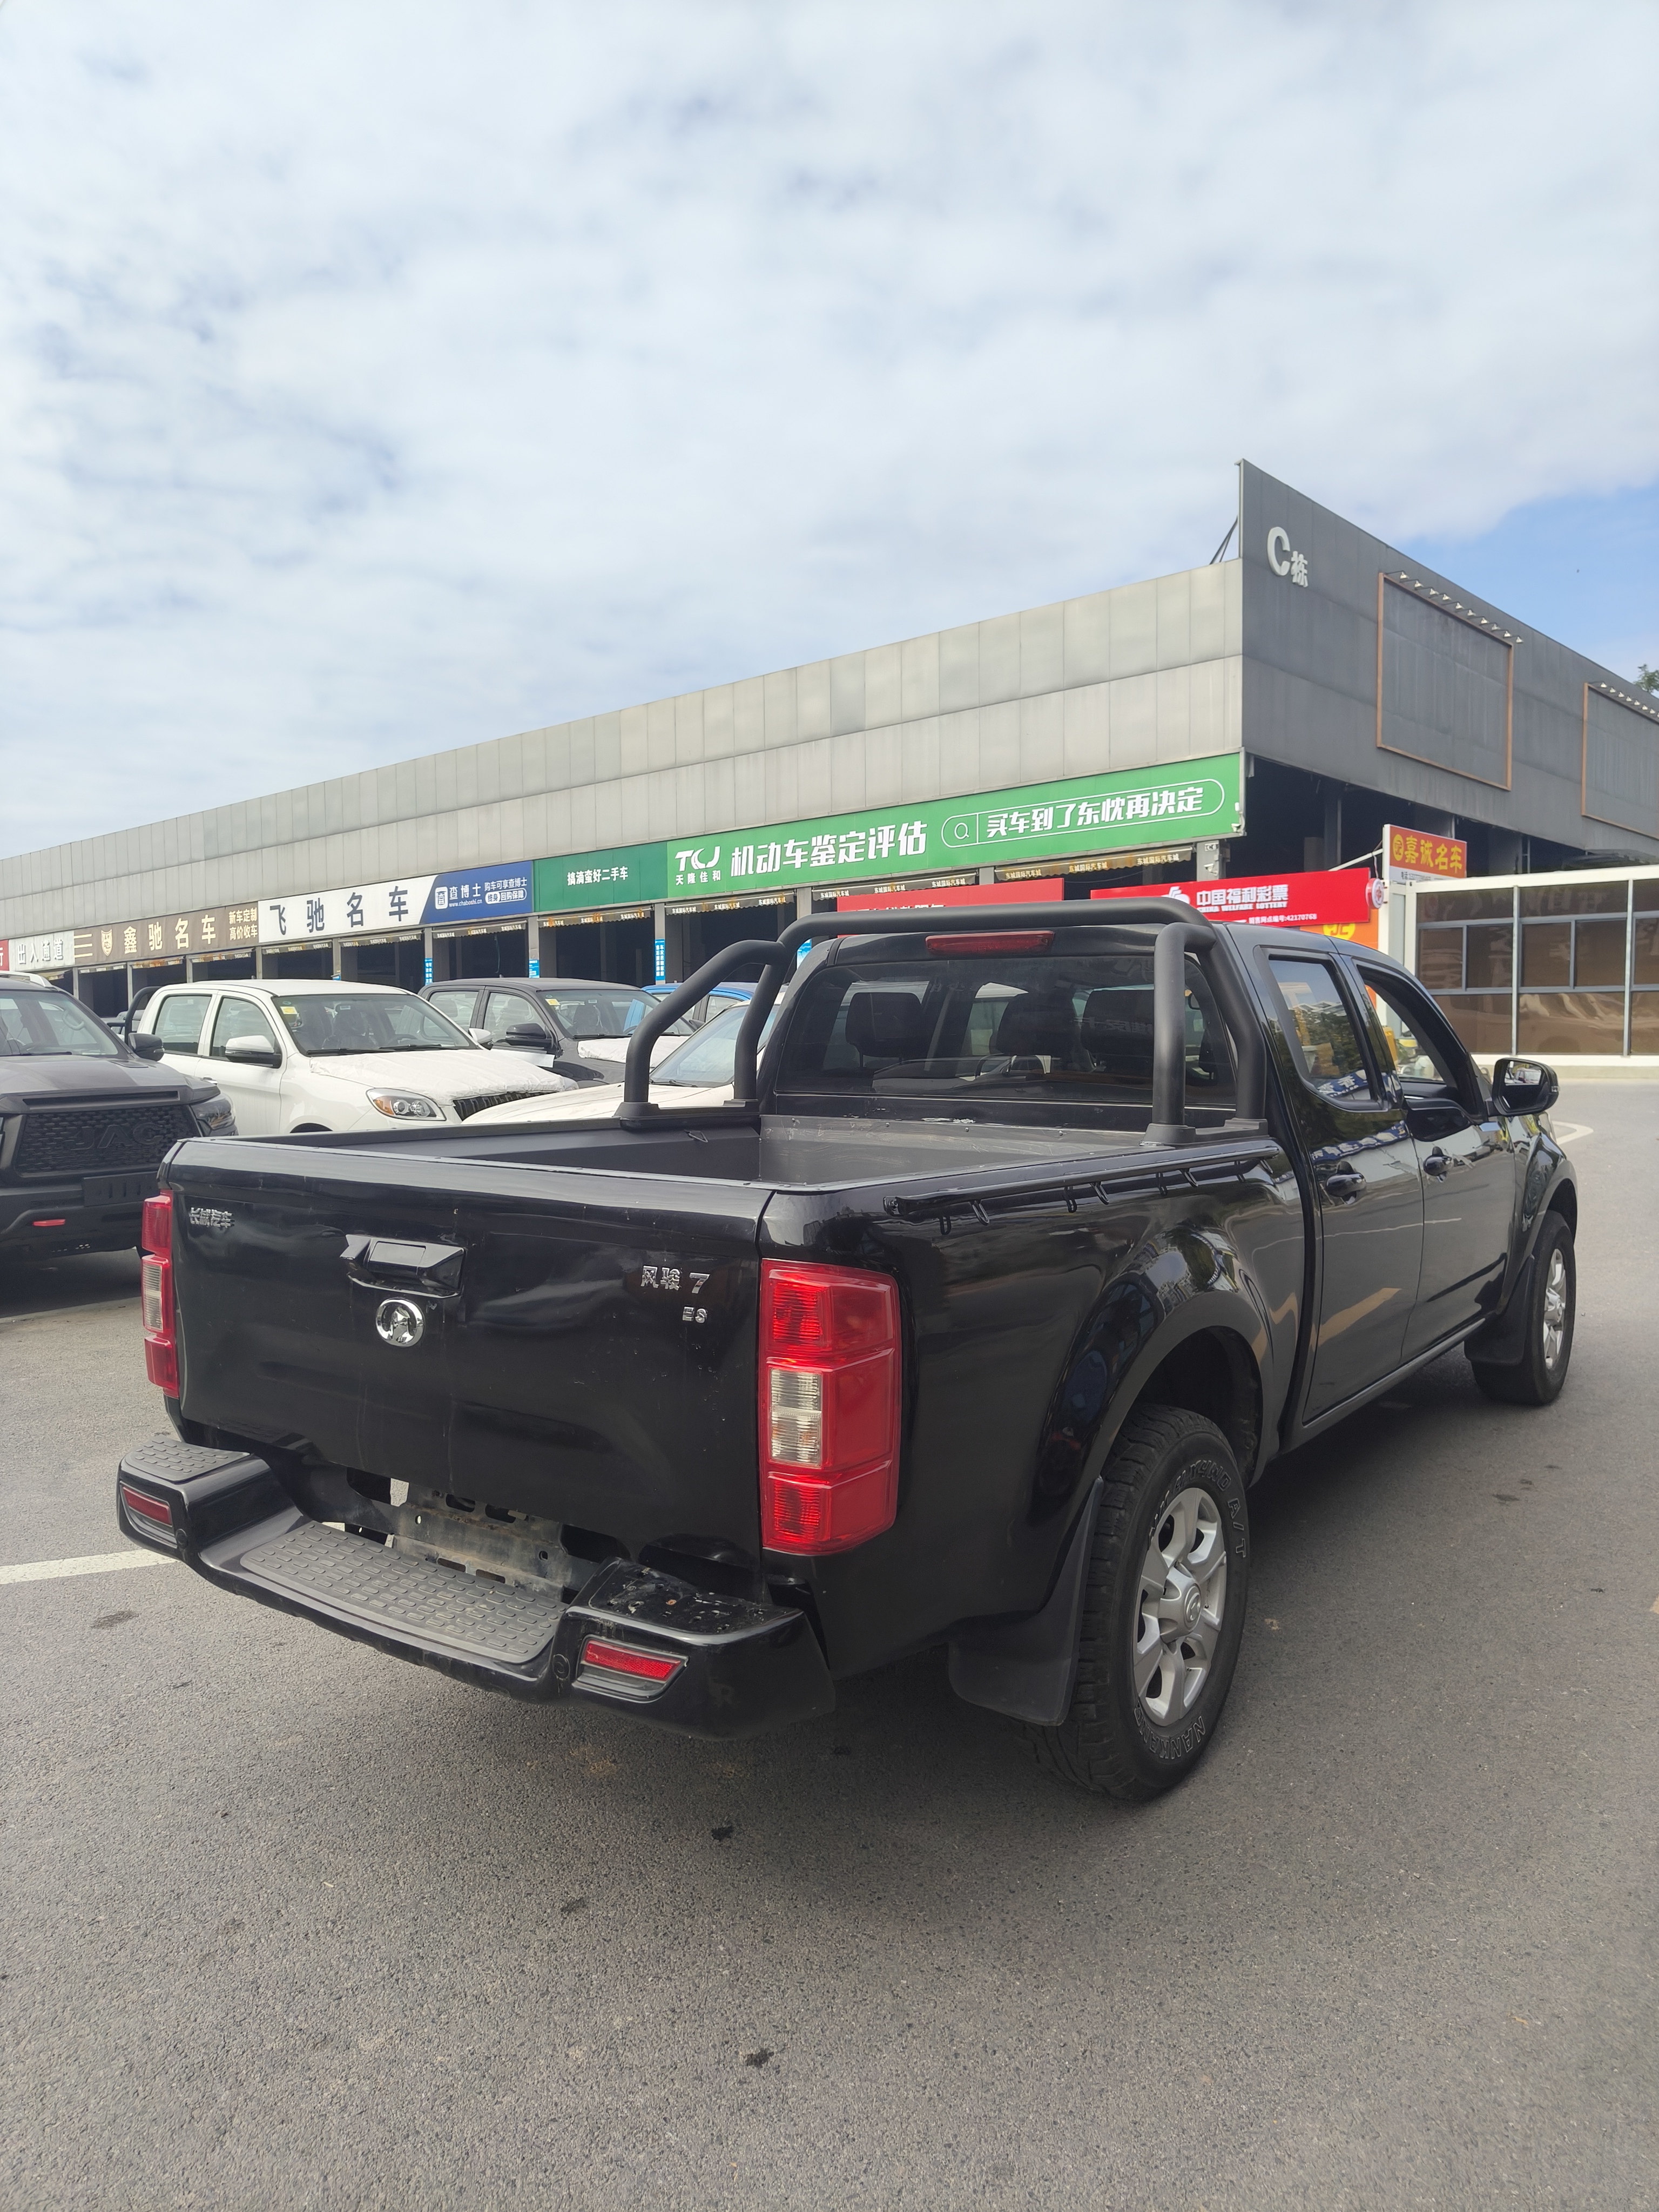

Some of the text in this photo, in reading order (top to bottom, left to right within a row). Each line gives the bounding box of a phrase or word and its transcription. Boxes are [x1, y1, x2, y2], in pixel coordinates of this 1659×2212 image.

[1267, 527, 1309, 588] C栋
[987, 787, 1203, 838] 买车到了东忱再决定
[731, 820, 927, 877] 机动车鉴定评估
[1404, 835, 1462, 873] 嘉诚名车
[1068, 861, 1108, 873] 东城国际汽车城
[1137, 854, 1179, 865] 东城国际汽车城
[484, 877, 528, 891] 购车可享查博士
[567, 866, 629, 886] 搞滴蛮好二手车
[676, 870, 721, 886] 天隆佳和
[931, 878, 966, 887] 东城国际汽车城
[449, 883, 481, 900] 查博士
[1196, 884, 1289, 906] 中国福利彩票
[229, 907, 257, 925] 新车定制
[269, 886, 409, 935] 飞驰名车
[124, 914, 216, 954] 鑫驰名车
[230, 925, 258, 941] 高价收车
[17, 938, 64, 965] 出入通道
[70, 1122, 163, 1151] JAC
[189, 1207, 233, 1228] 长城汽车
[683, 1306, 707, 1323] ES
